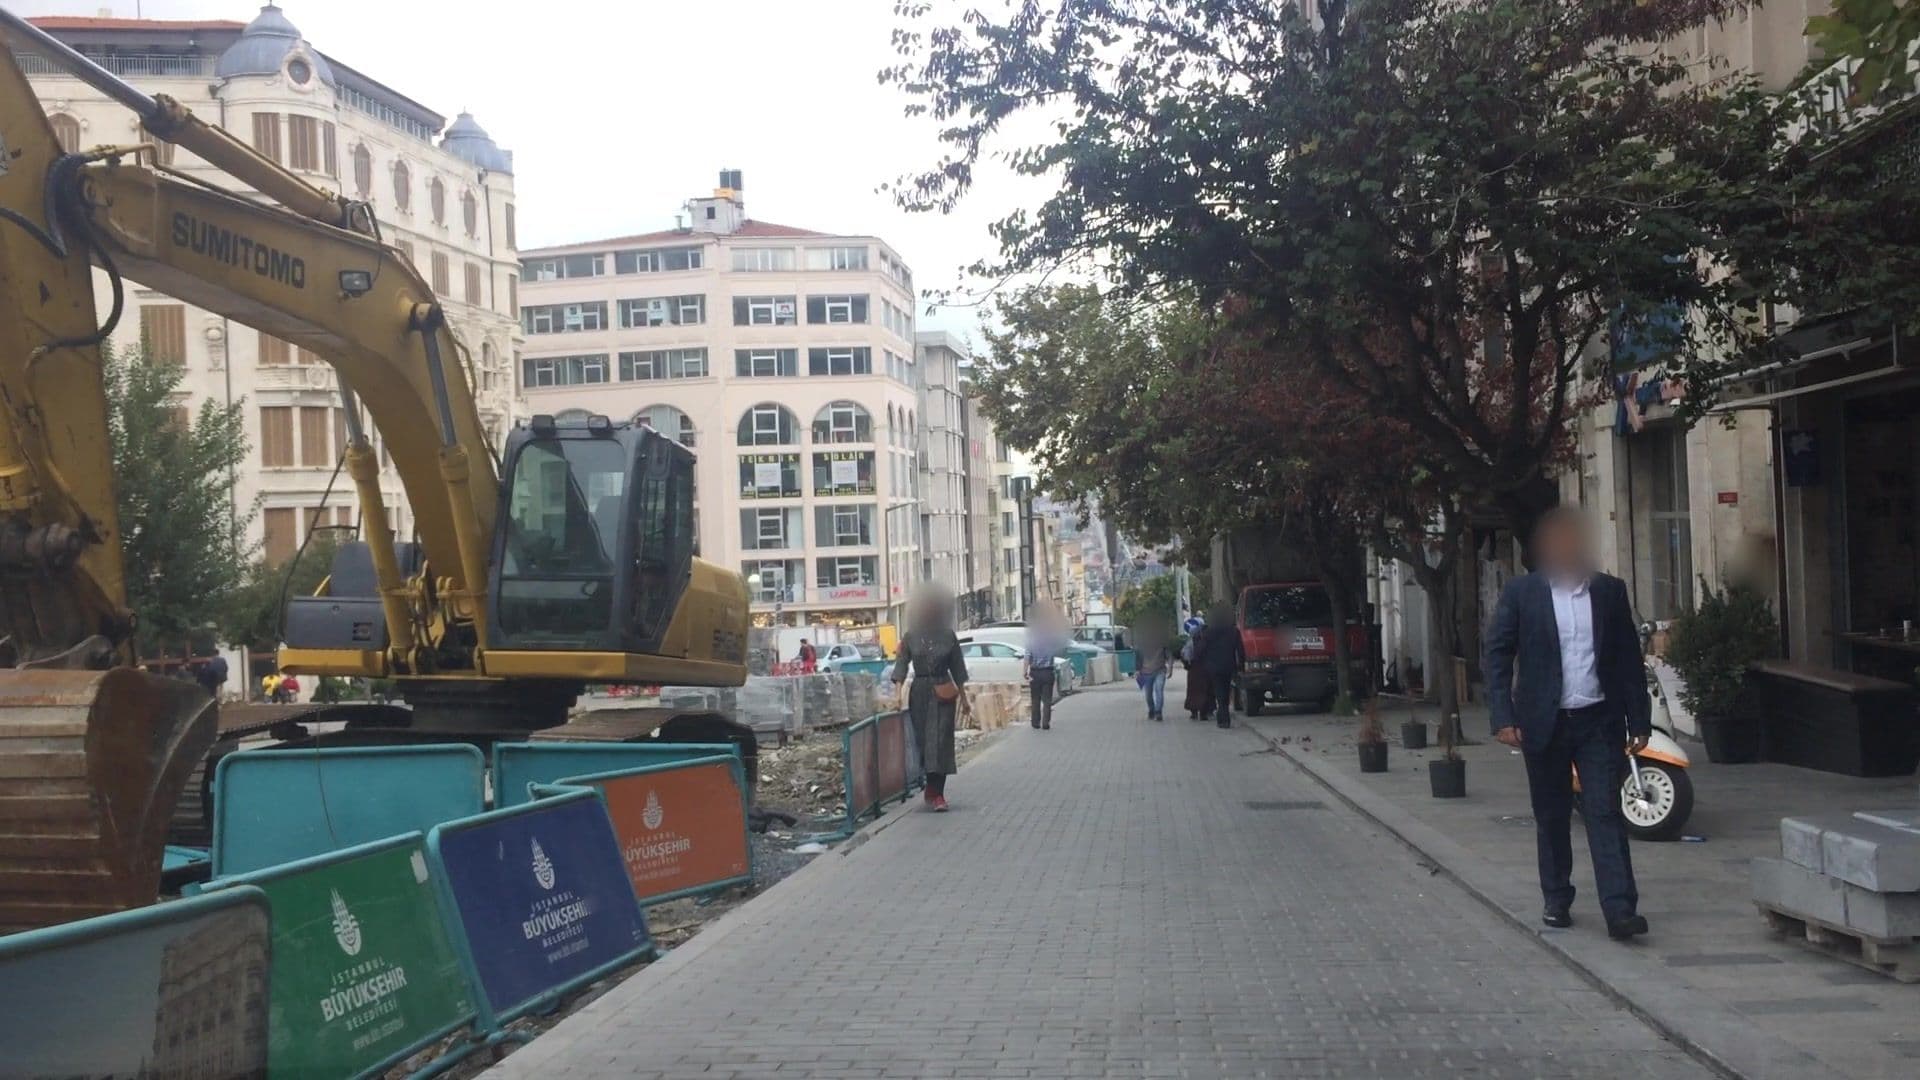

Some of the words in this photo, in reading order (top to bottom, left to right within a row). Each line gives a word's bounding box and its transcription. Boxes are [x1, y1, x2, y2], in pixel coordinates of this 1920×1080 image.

[172, 211, 306, 289] SUMITOMO
[625, 836, 691, 862] ÜYÜKŞEHİR
[332, 955, 386, 985] İSTANBUL
[320, 963, 408, 1022] BÜYÜKŞEHİR
